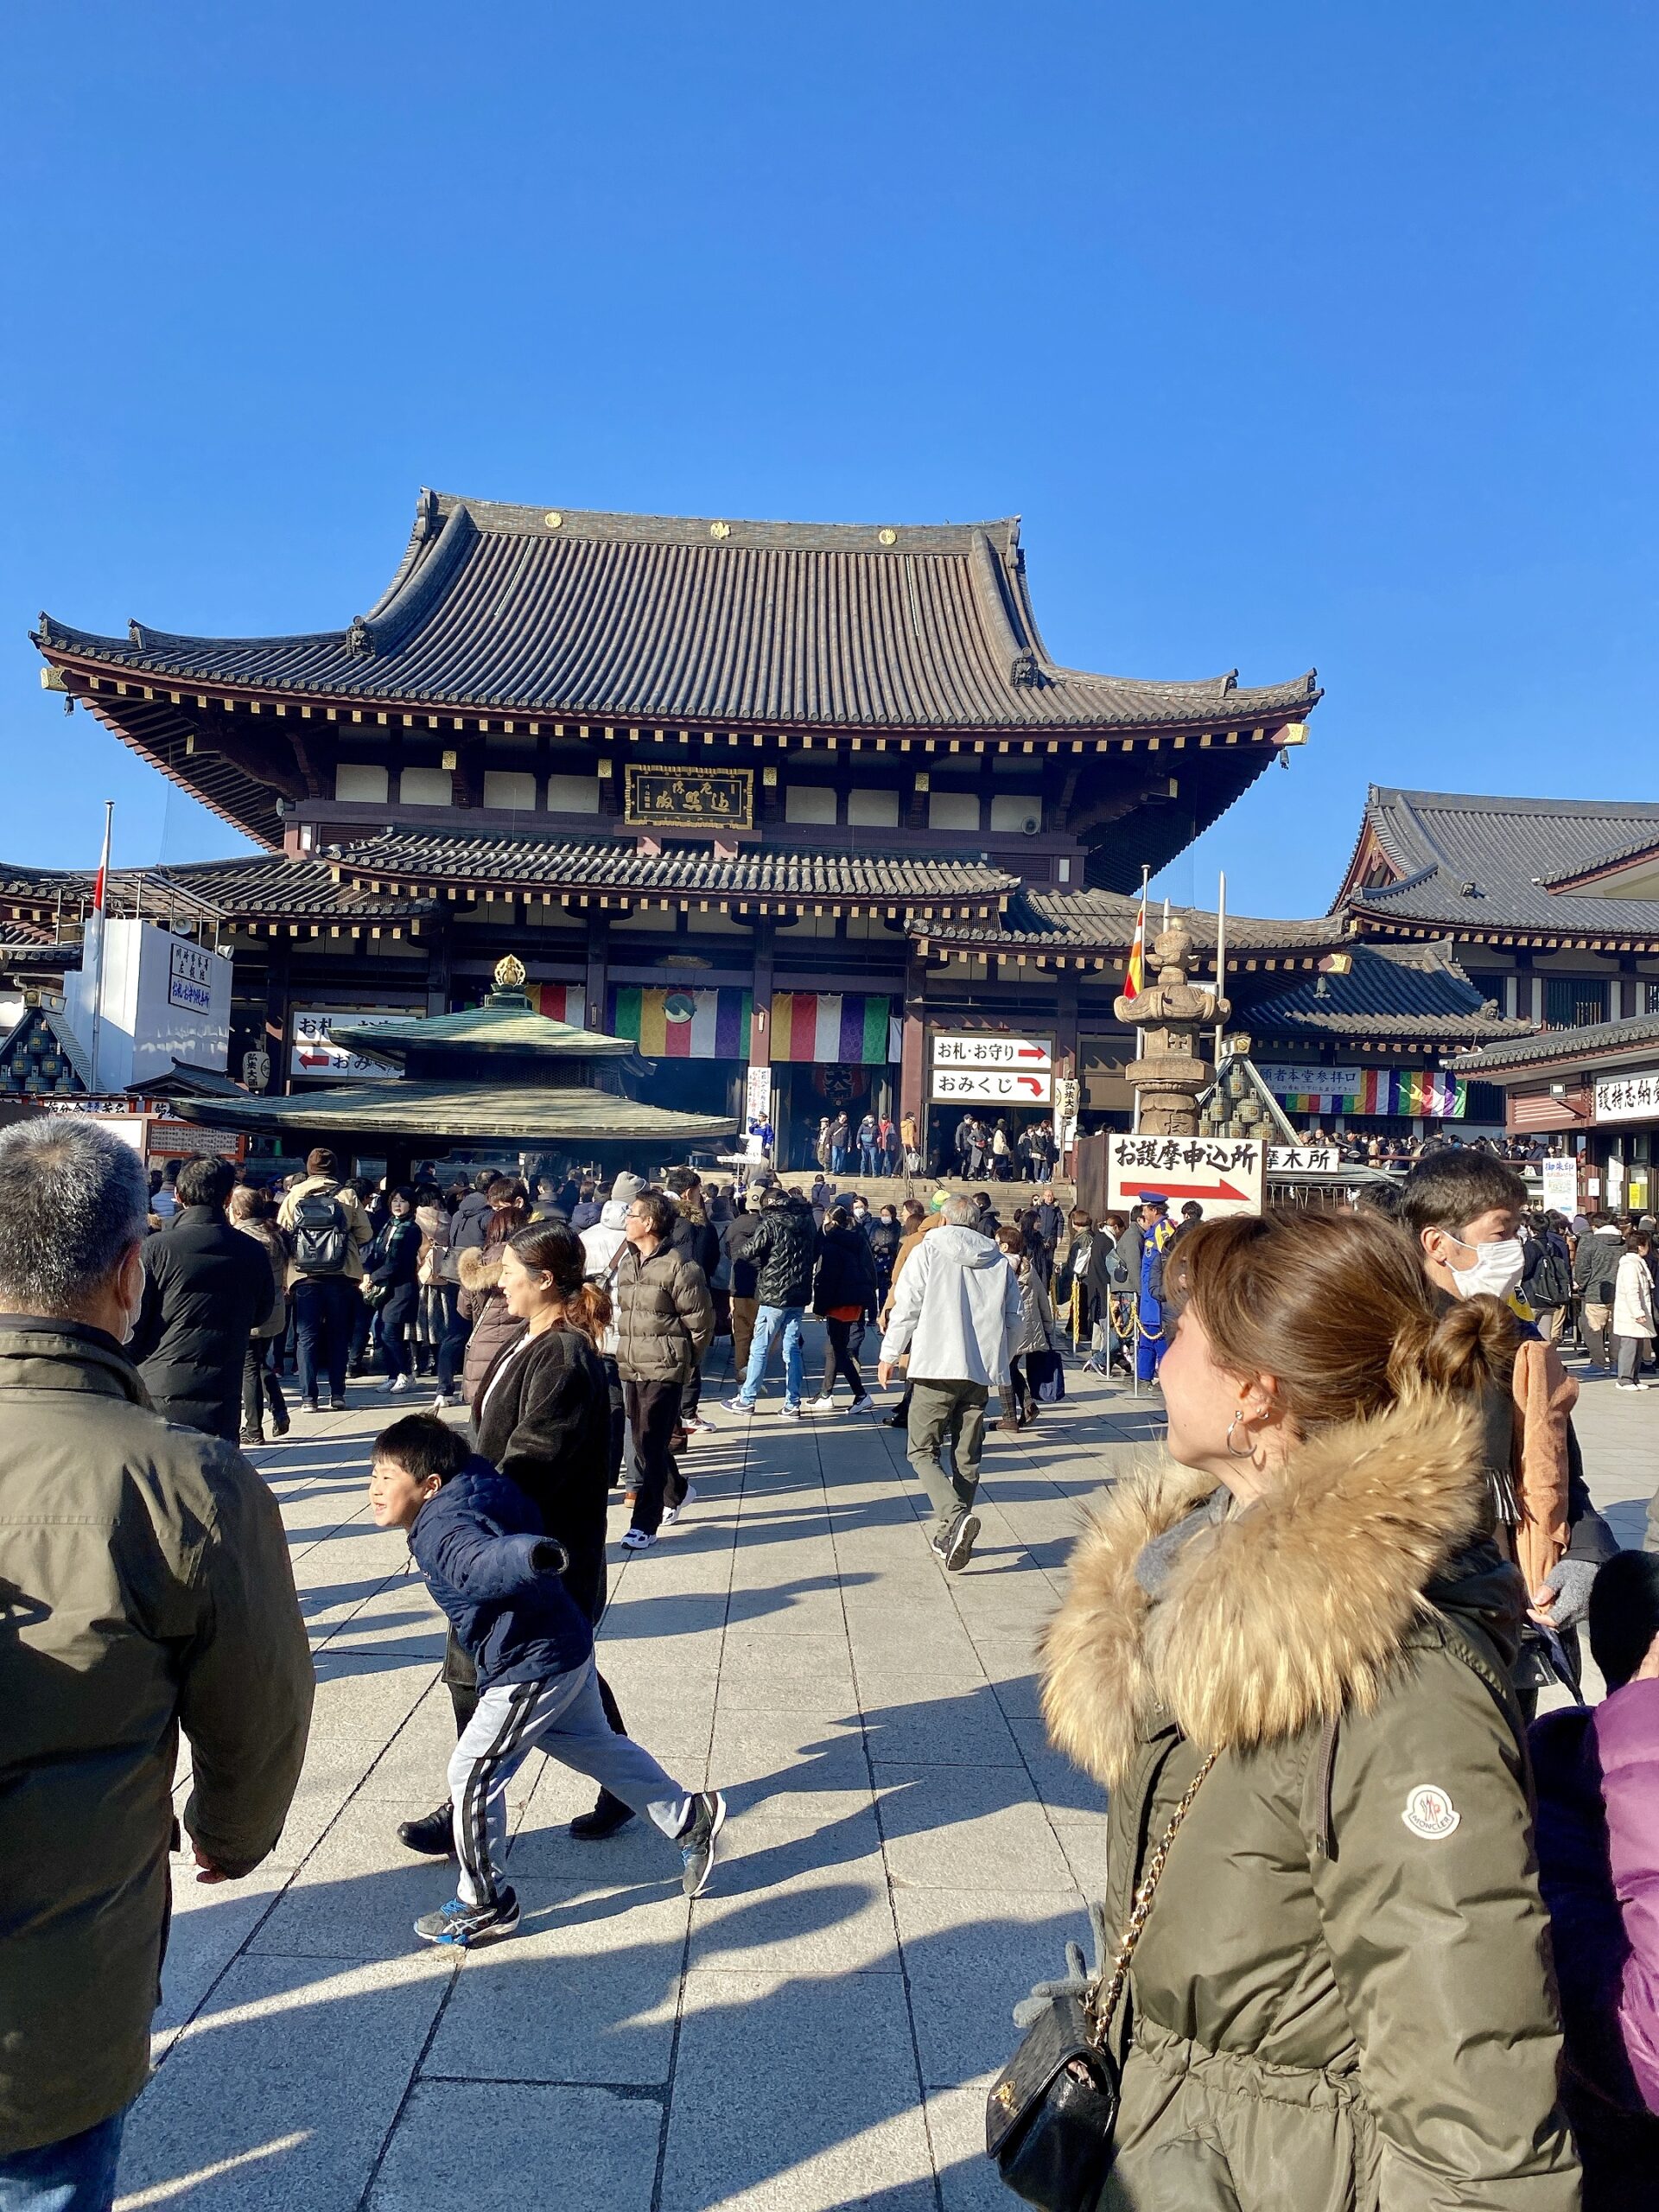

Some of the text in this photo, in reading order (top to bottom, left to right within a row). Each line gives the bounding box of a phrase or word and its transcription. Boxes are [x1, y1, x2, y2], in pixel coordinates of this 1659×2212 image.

[938, 1076, 1013, 1094] おみくじ
[1064, 1082, 1075, 1116] 弘法大師
[1115, 1139, 1258, 1175] お護摩申込所
[1545, 1161, 1574, 1172] 御朱印
[1412, 1815, 1450, 1830] MONCLER
